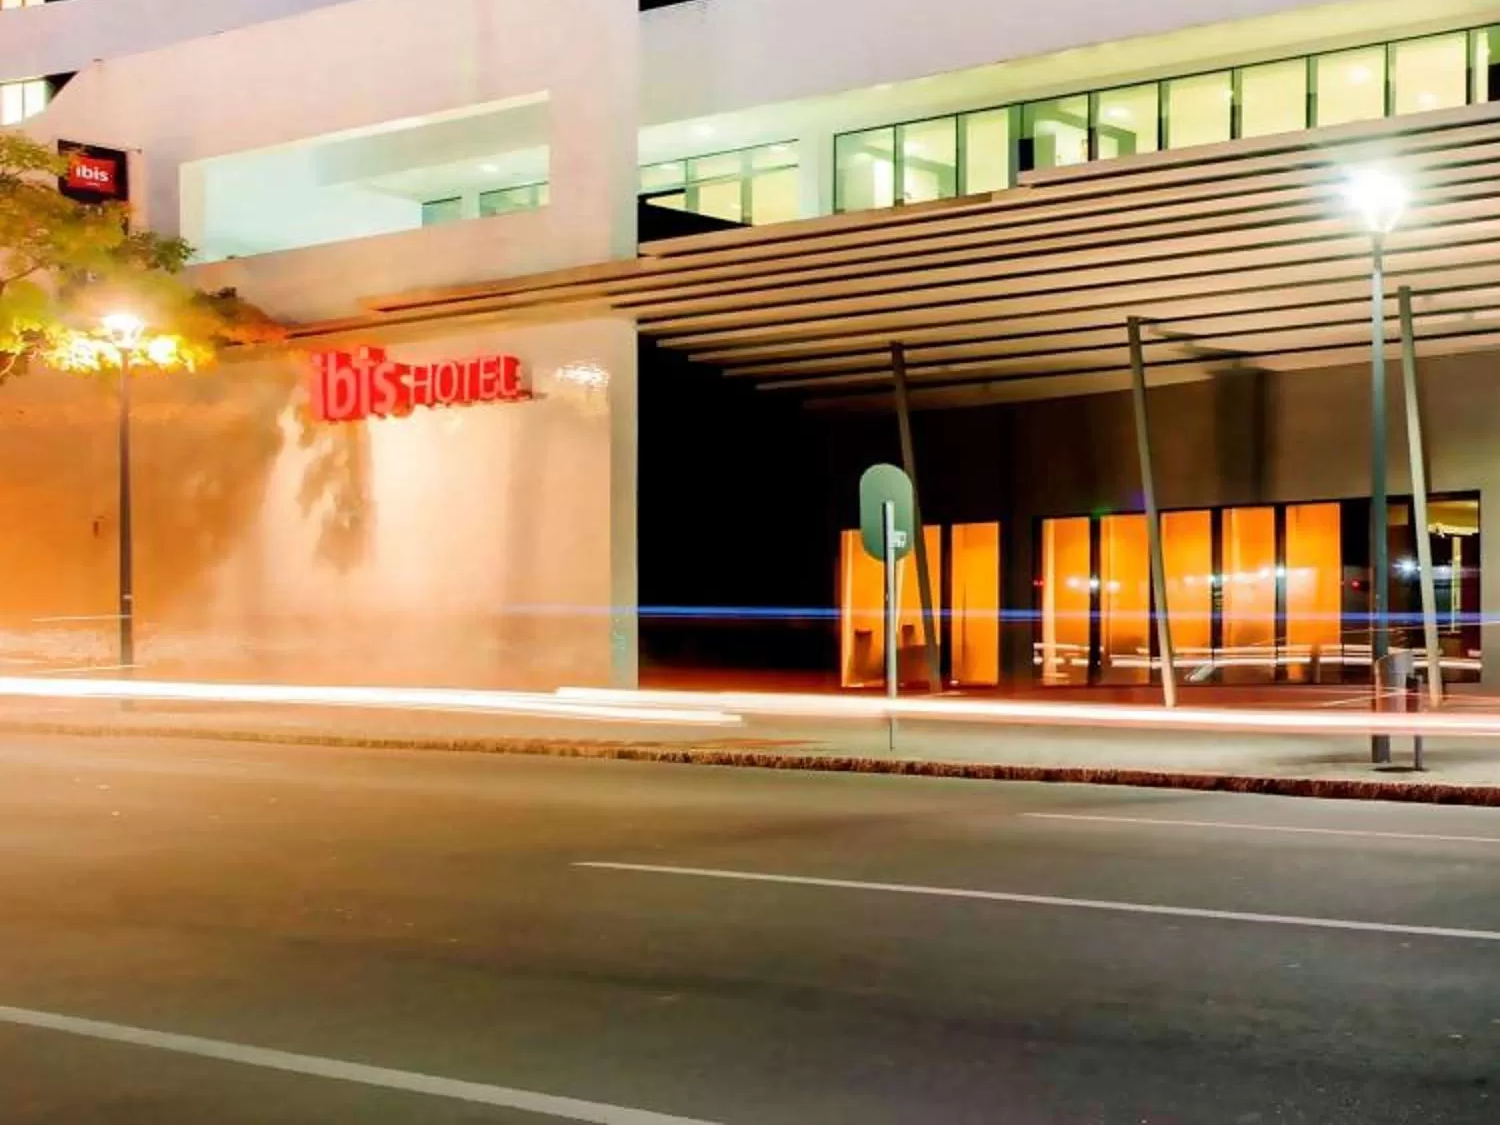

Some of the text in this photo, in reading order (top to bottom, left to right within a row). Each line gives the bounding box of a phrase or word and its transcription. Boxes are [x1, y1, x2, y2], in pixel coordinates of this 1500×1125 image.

[75, 164, 109, 182] ibis
[312, 346, 521, 419] ibis HOTEL
